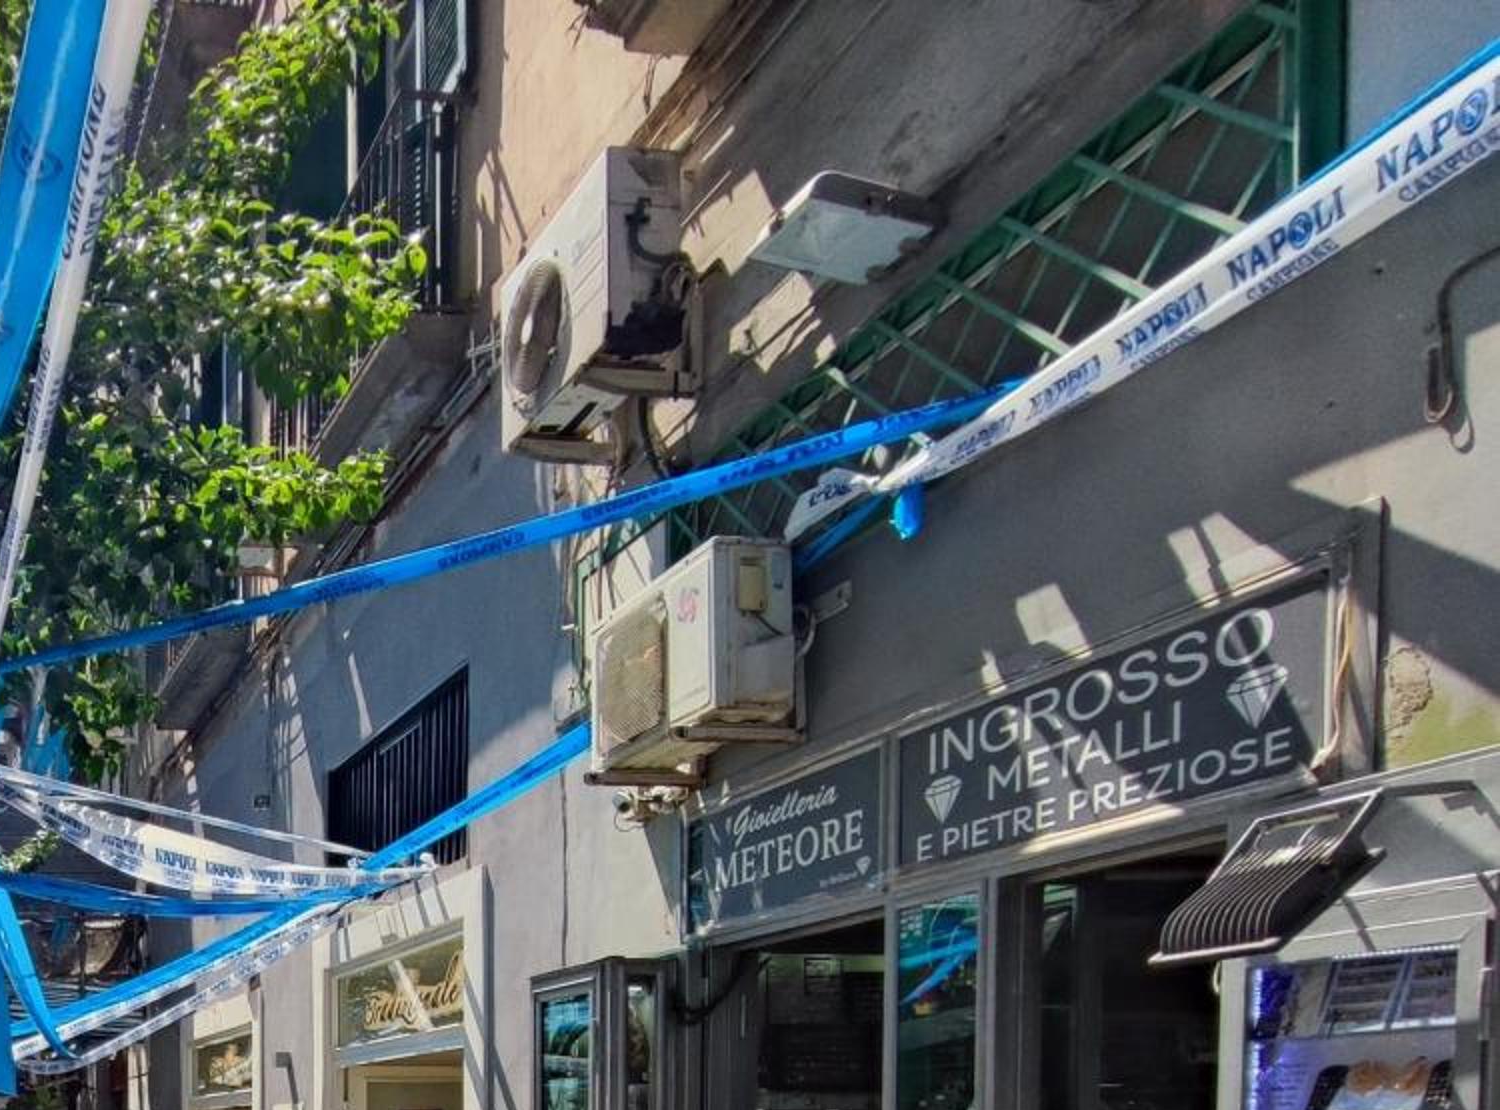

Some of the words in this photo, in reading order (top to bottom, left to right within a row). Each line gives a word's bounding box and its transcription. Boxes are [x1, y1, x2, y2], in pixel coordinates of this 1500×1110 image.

[1375, 75, 1500, 193] NAPO
[1398, 124, 1500, 202] CAMPIO
[1226, 186, 1346, 290] NAPOLI
[1114, 282, 1208, 361] NAPOLI
[928, 607, 1275, 775] INGROSSO
[916, 833, 933, 863] E
[943, 797, 1057, 856] PIETRE
[1067, 727, 1294, 822] PREZIOSE
[987, 700, 1182, 801] METALLI
[714, 809, 865, 893] METEORE
[733, 785, 838, 848] Gioielleria
